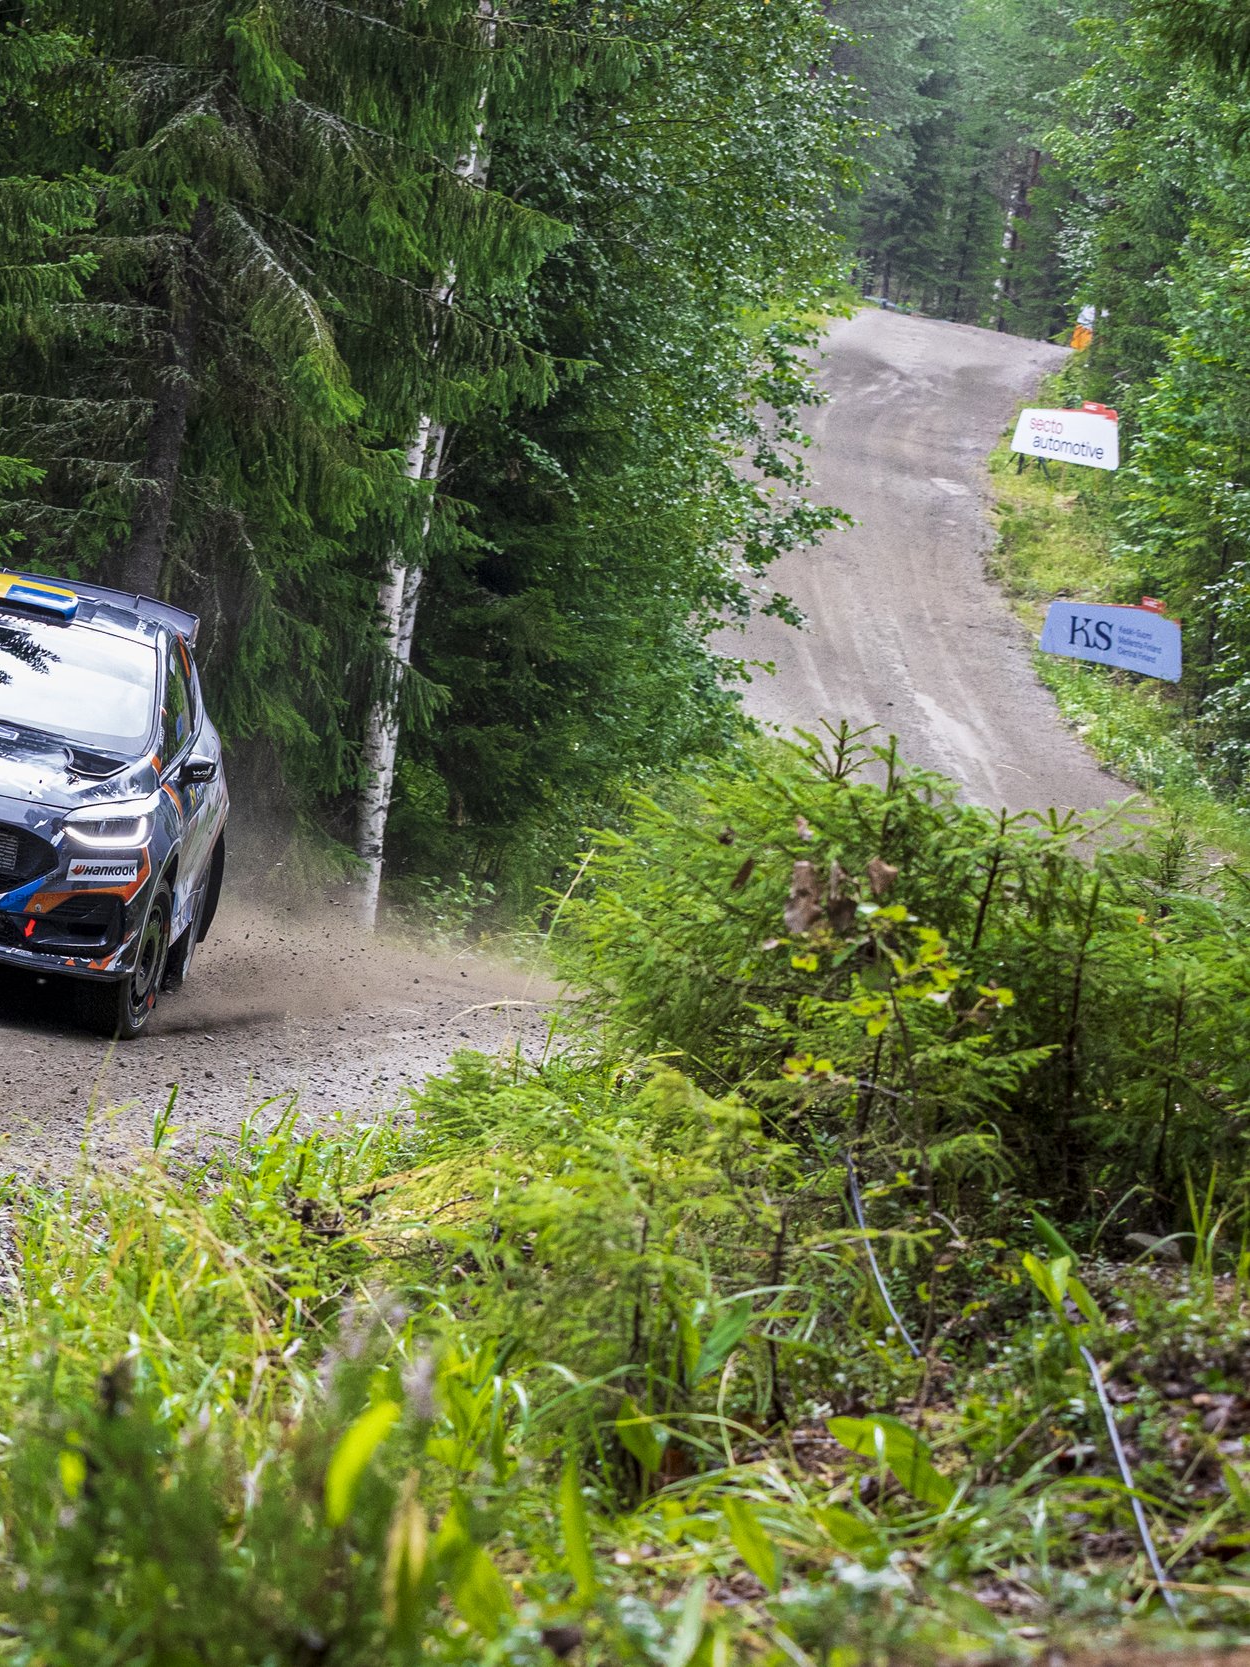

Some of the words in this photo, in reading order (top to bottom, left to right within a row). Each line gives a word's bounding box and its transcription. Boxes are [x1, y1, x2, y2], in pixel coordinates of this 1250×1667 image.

[1030, 417, 1064, 435] secto
[1033, 435, 1104, 460] automotive
[1069, 615, 1114, 651] KS
